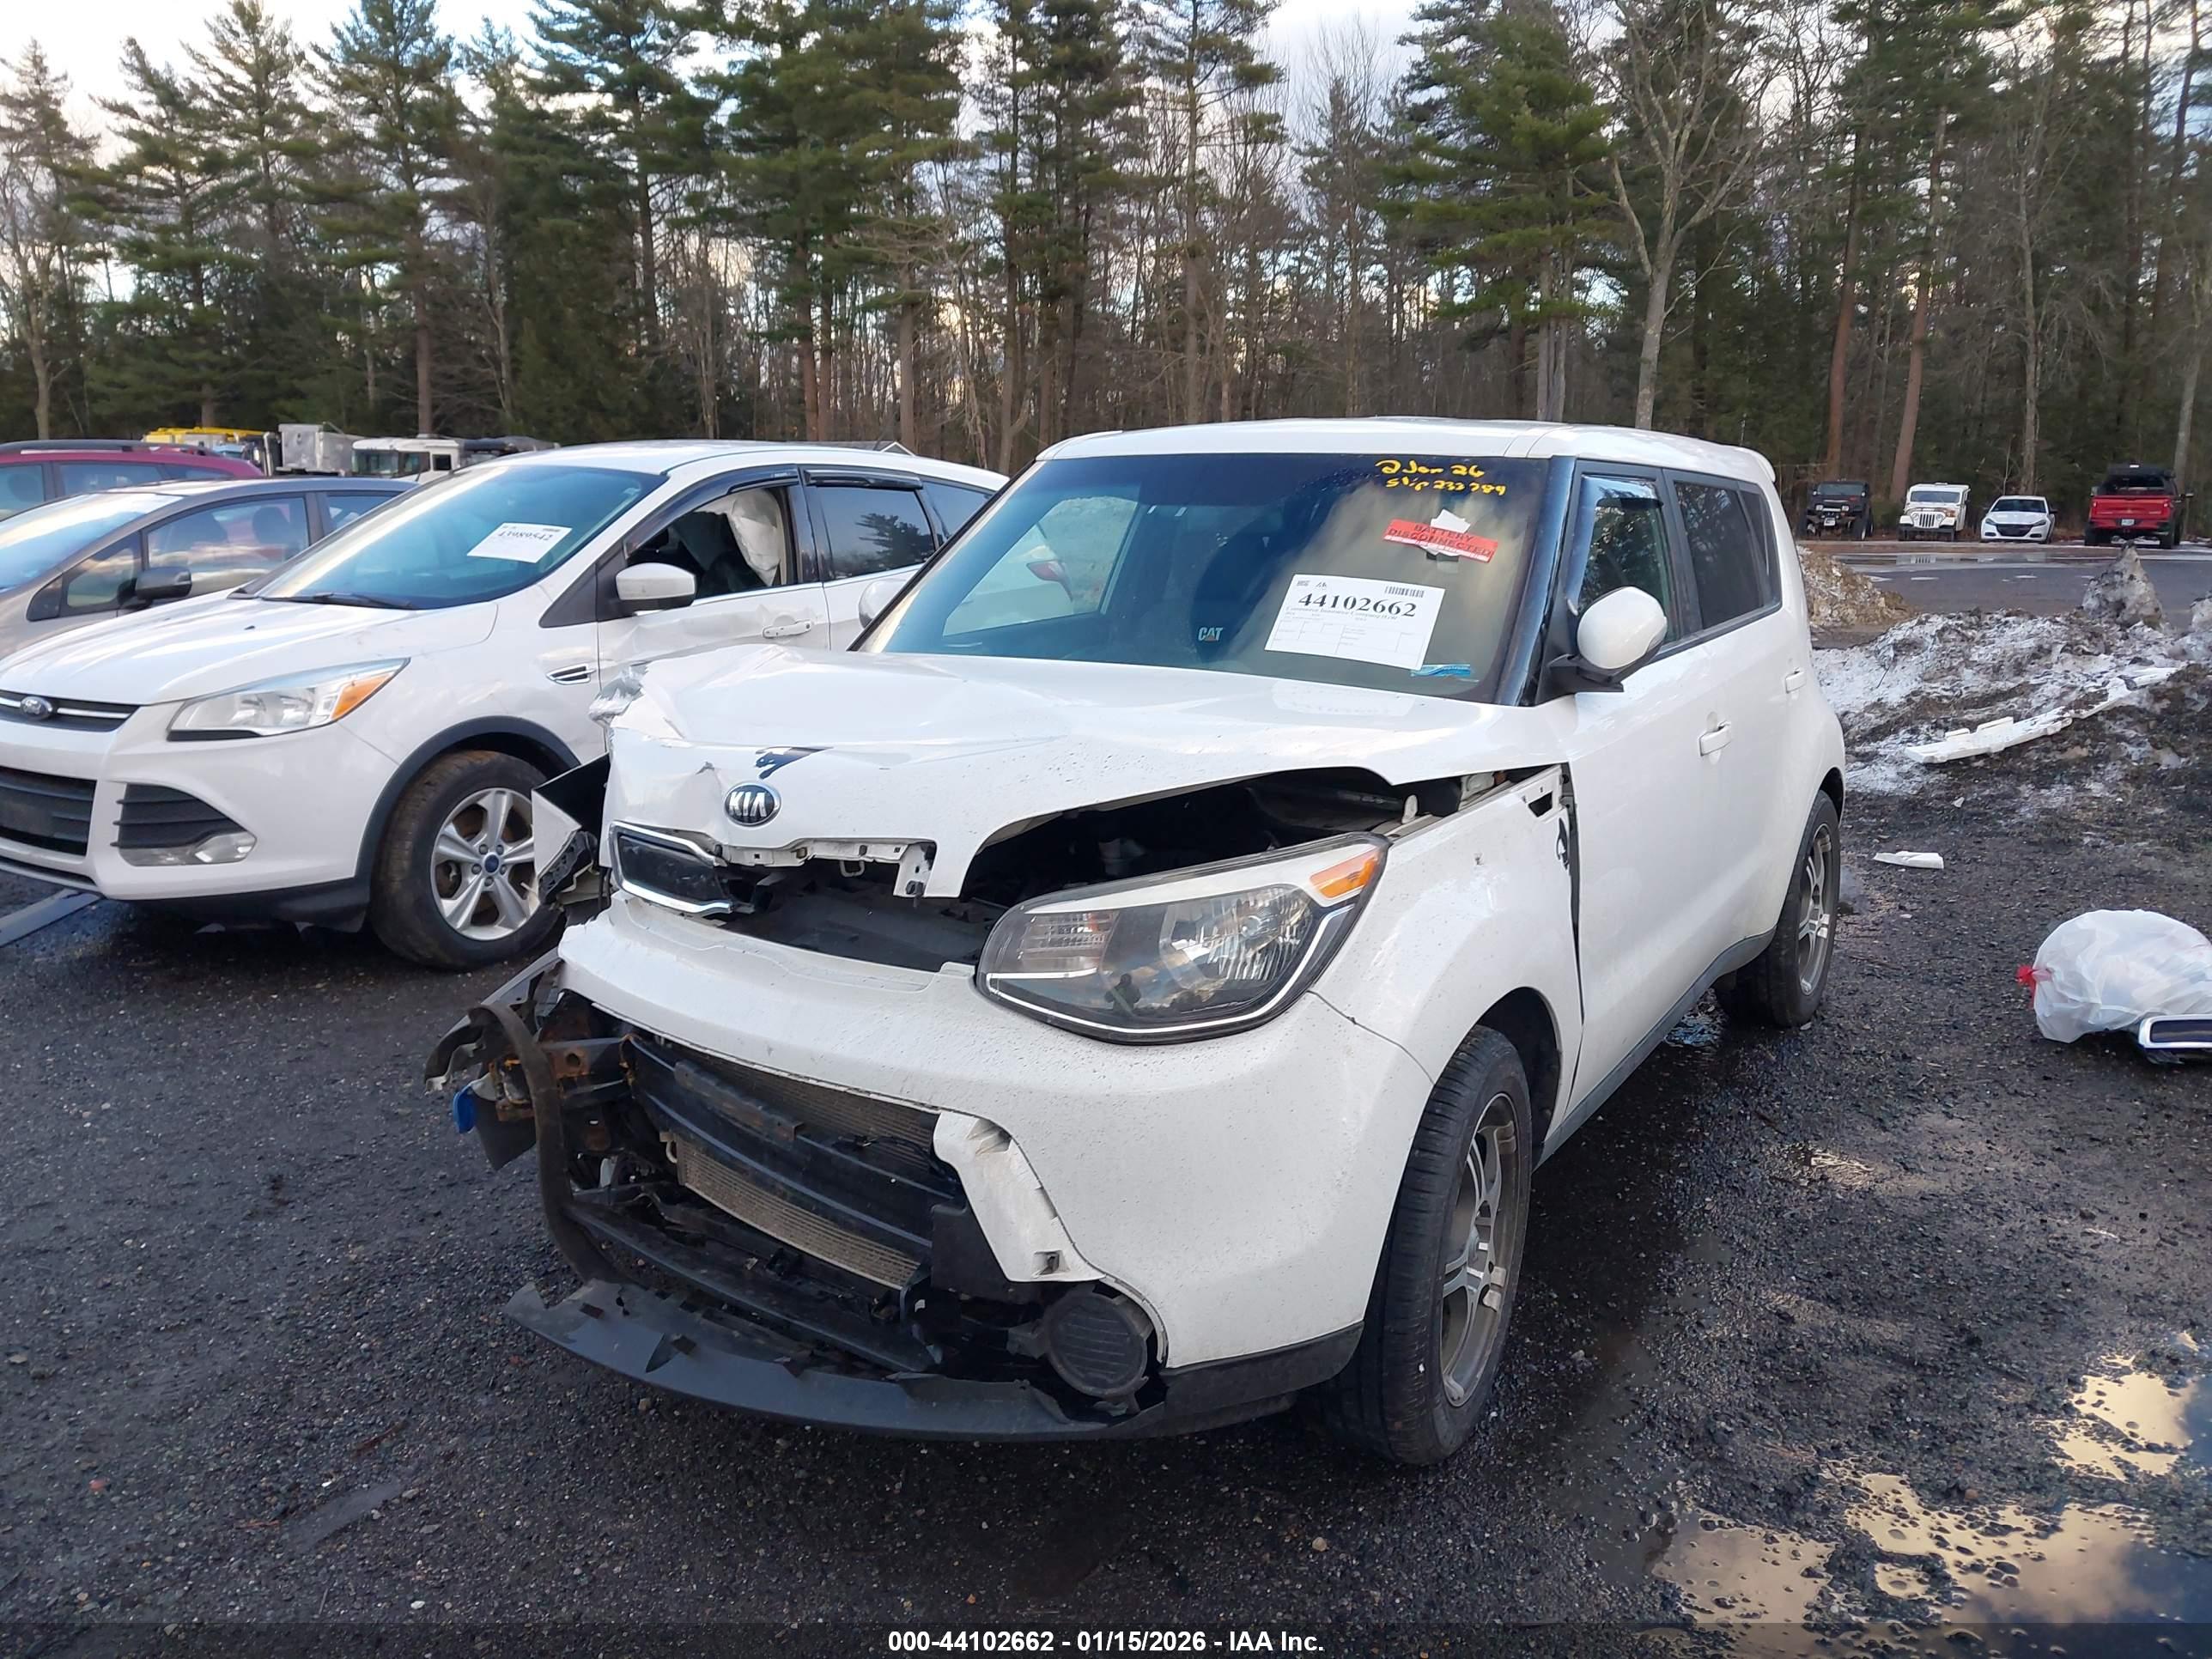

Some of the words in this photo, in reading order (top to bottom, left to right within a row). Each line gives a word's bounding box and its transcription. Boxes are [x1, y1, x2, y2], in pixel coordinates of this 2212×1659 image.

[1387, 528, 1492, 556] DISCONNECTED
[1414, 525, 1474, 542] BATTERY
[1298, 592, 1417, 617] 44102662
[1198, 627, 1223, 641] CAT
[728, 791, 767, 817] KIA
